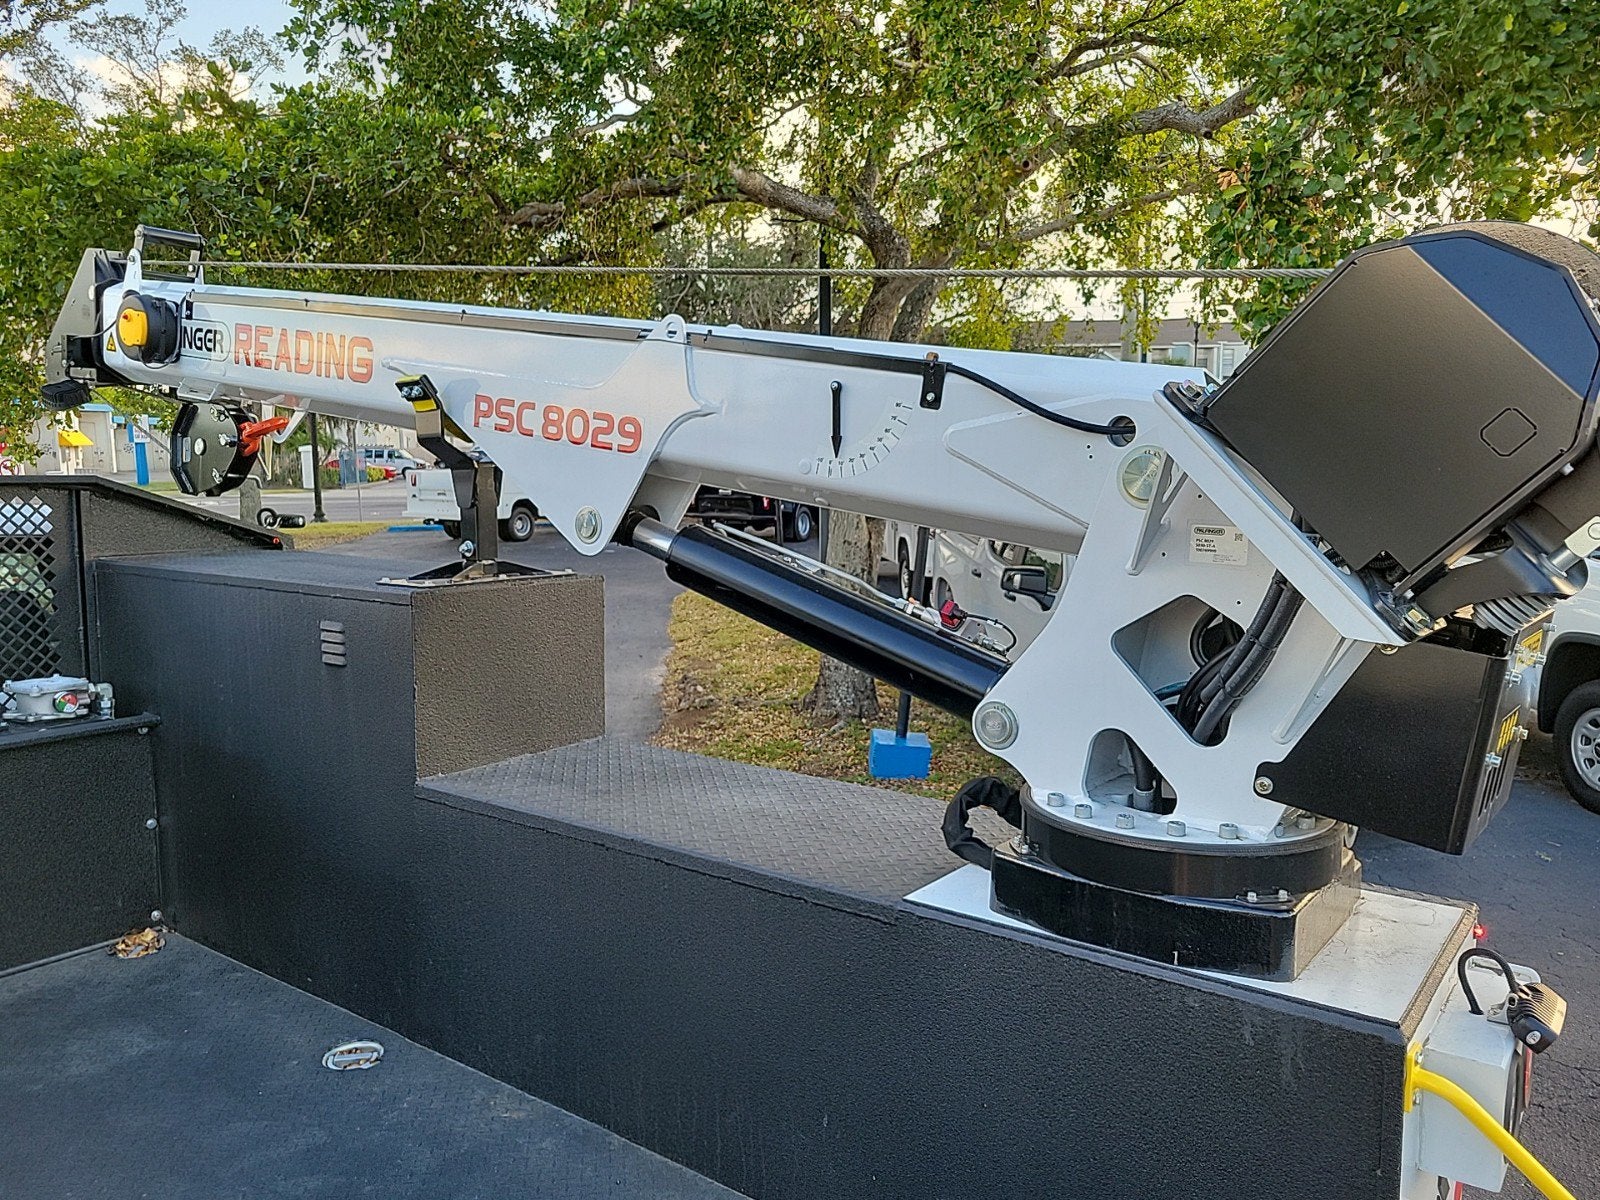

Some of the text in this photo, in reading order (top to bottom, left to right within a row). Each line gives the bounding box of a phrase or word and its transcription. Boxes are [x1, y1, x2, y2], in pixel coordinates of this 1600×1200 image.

[234, 322, 375, 384] READING
[473, 393, 643, 454] PSC 8029
